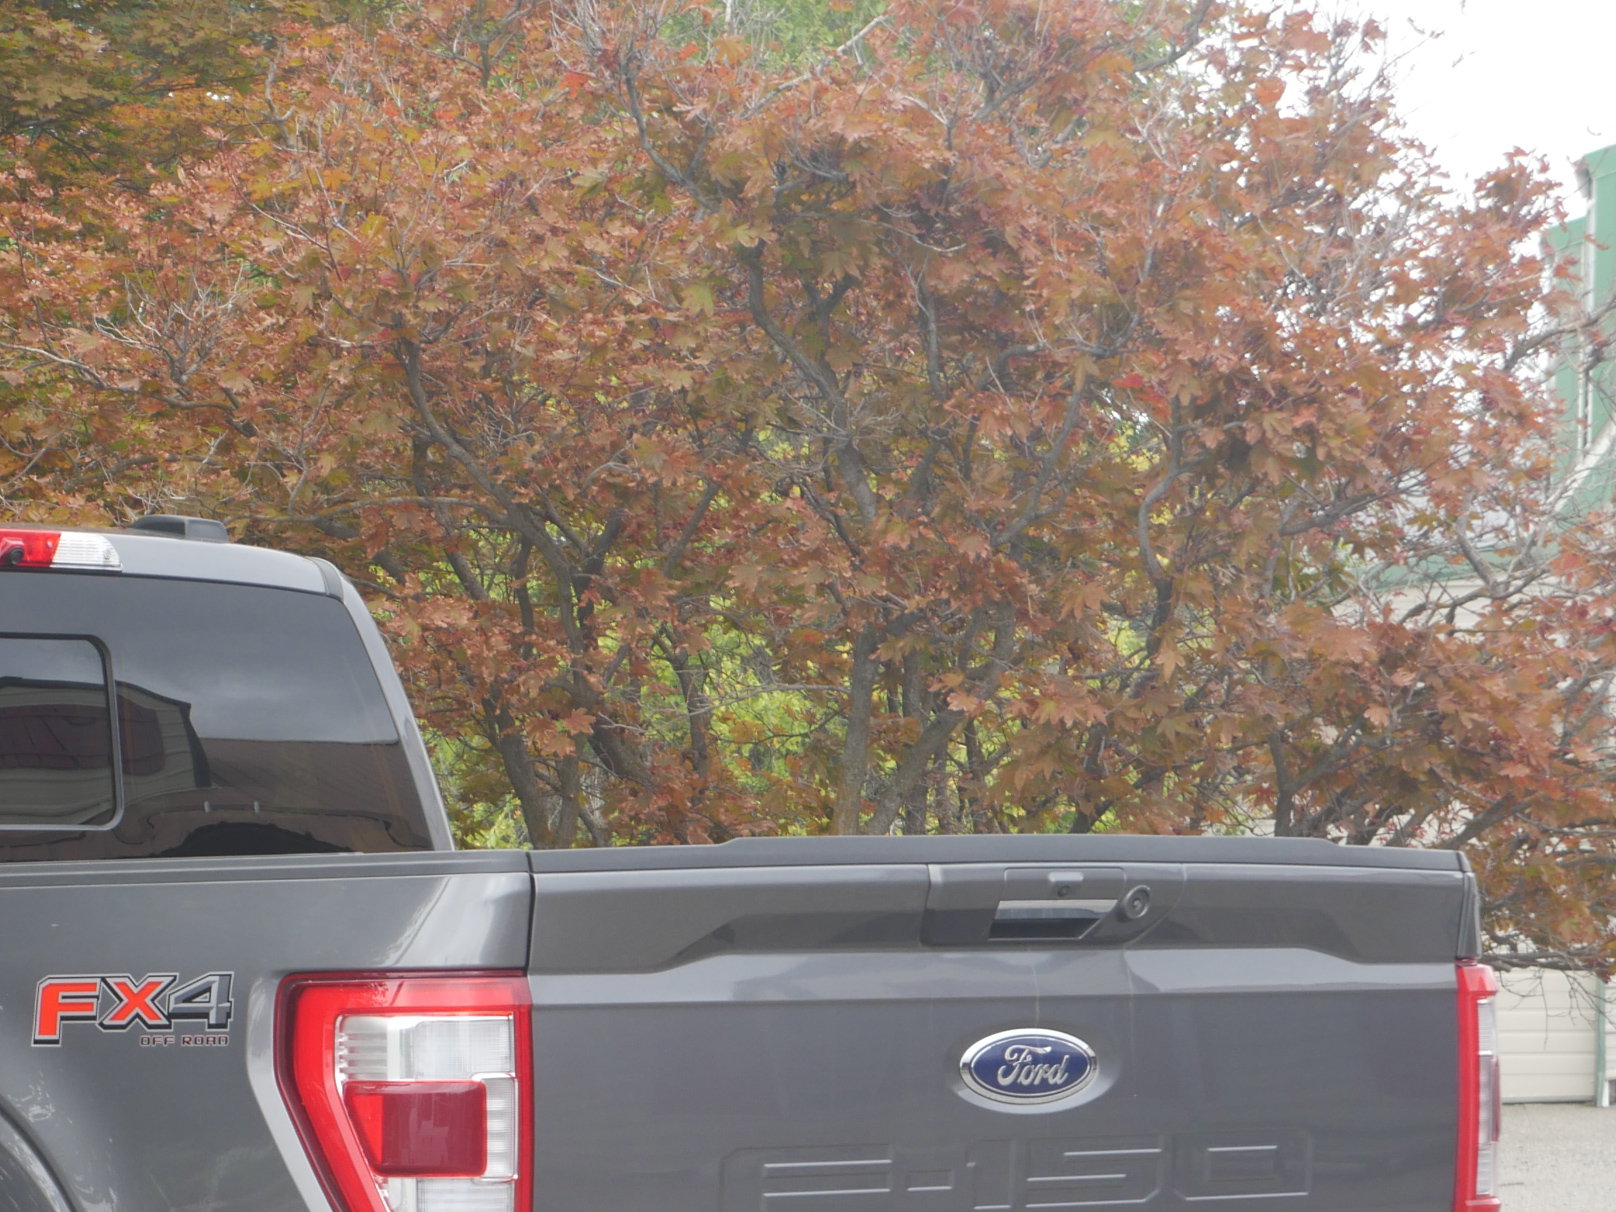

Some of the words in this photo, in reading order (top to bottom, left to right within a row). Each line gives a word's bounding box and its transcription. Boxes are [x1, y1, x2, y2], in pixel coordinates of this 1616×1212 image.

[31, 971, 234, 1047] FX4
[140, 1035, 175, 1046] OFF
[182, 1034, 230, 1046] ROAD
[996, 1044, 1068, 1087] Ford
